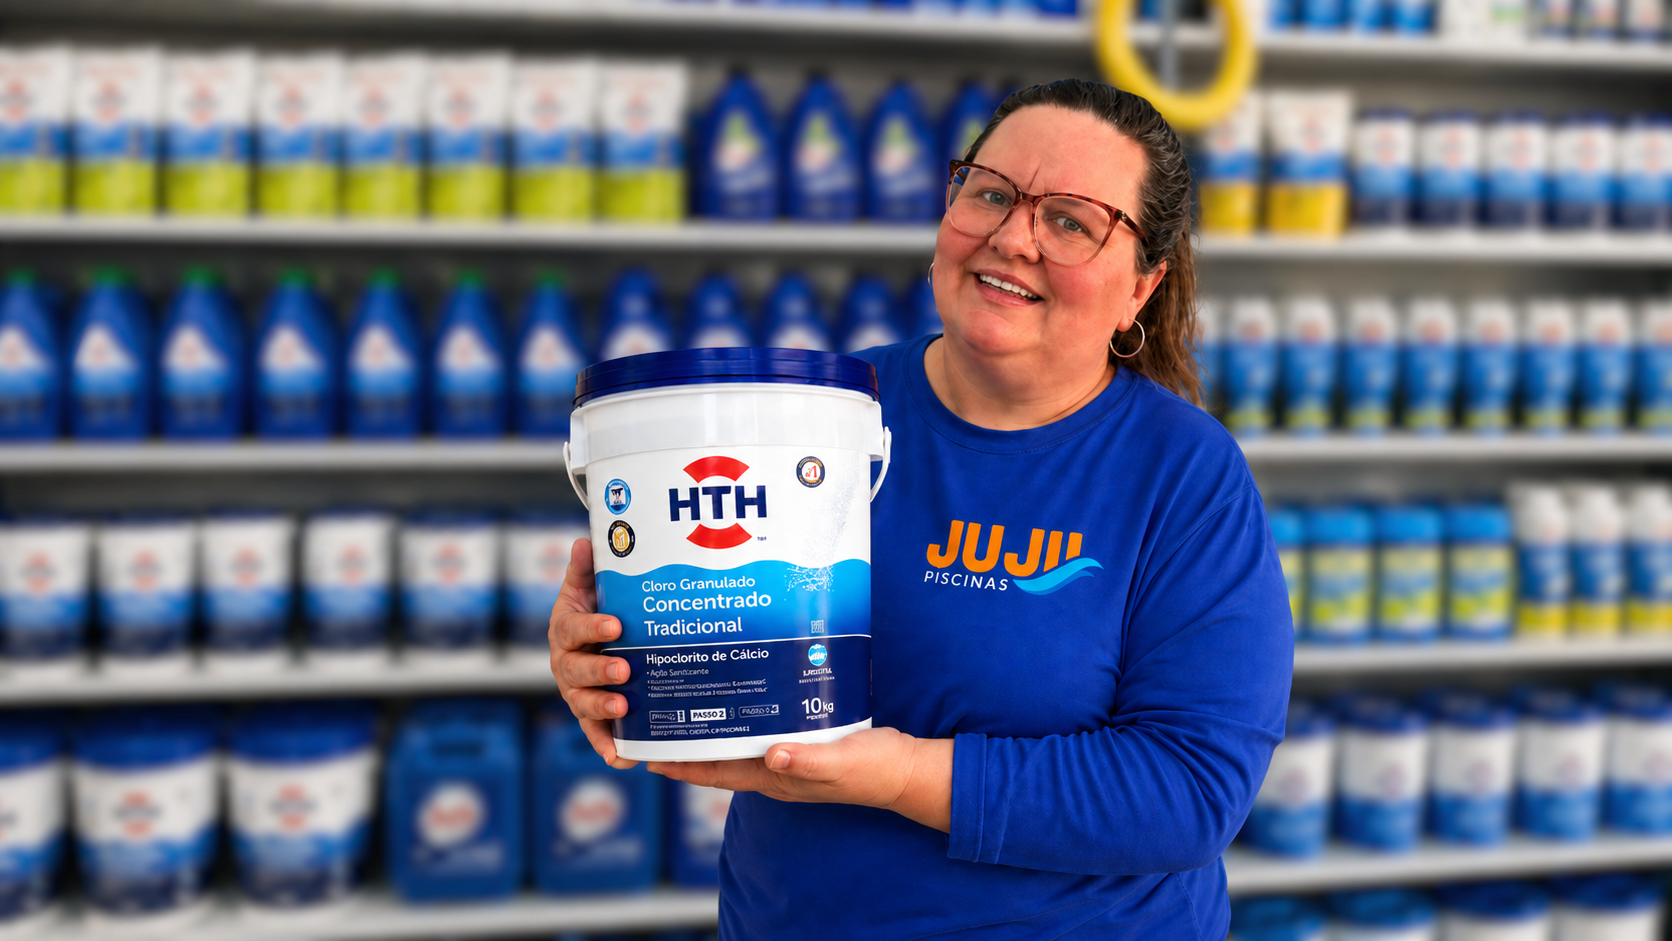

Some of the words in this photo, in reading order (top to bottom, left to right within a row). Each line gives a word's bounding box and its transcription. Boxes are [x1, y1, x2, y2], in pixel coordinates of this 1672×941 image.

[669, 485, 767, 522] HTH
[926, 519, 1083, 577] JUJU
[642, 579, 676, 592] Cloro
[680, 575, 756, 591] Granulado
[923, 570, 1009, 591] PISCINAS
[643, 591, 772, 613] Concentrado
[644, 617, 743, 637] Tradicional
[646, 652, 709, 667] Hipoclorito
[712, 650, 727, 661] de
[730, 648, 769, 661] Cálcio
[693, 711, 717, 719] PASSO
